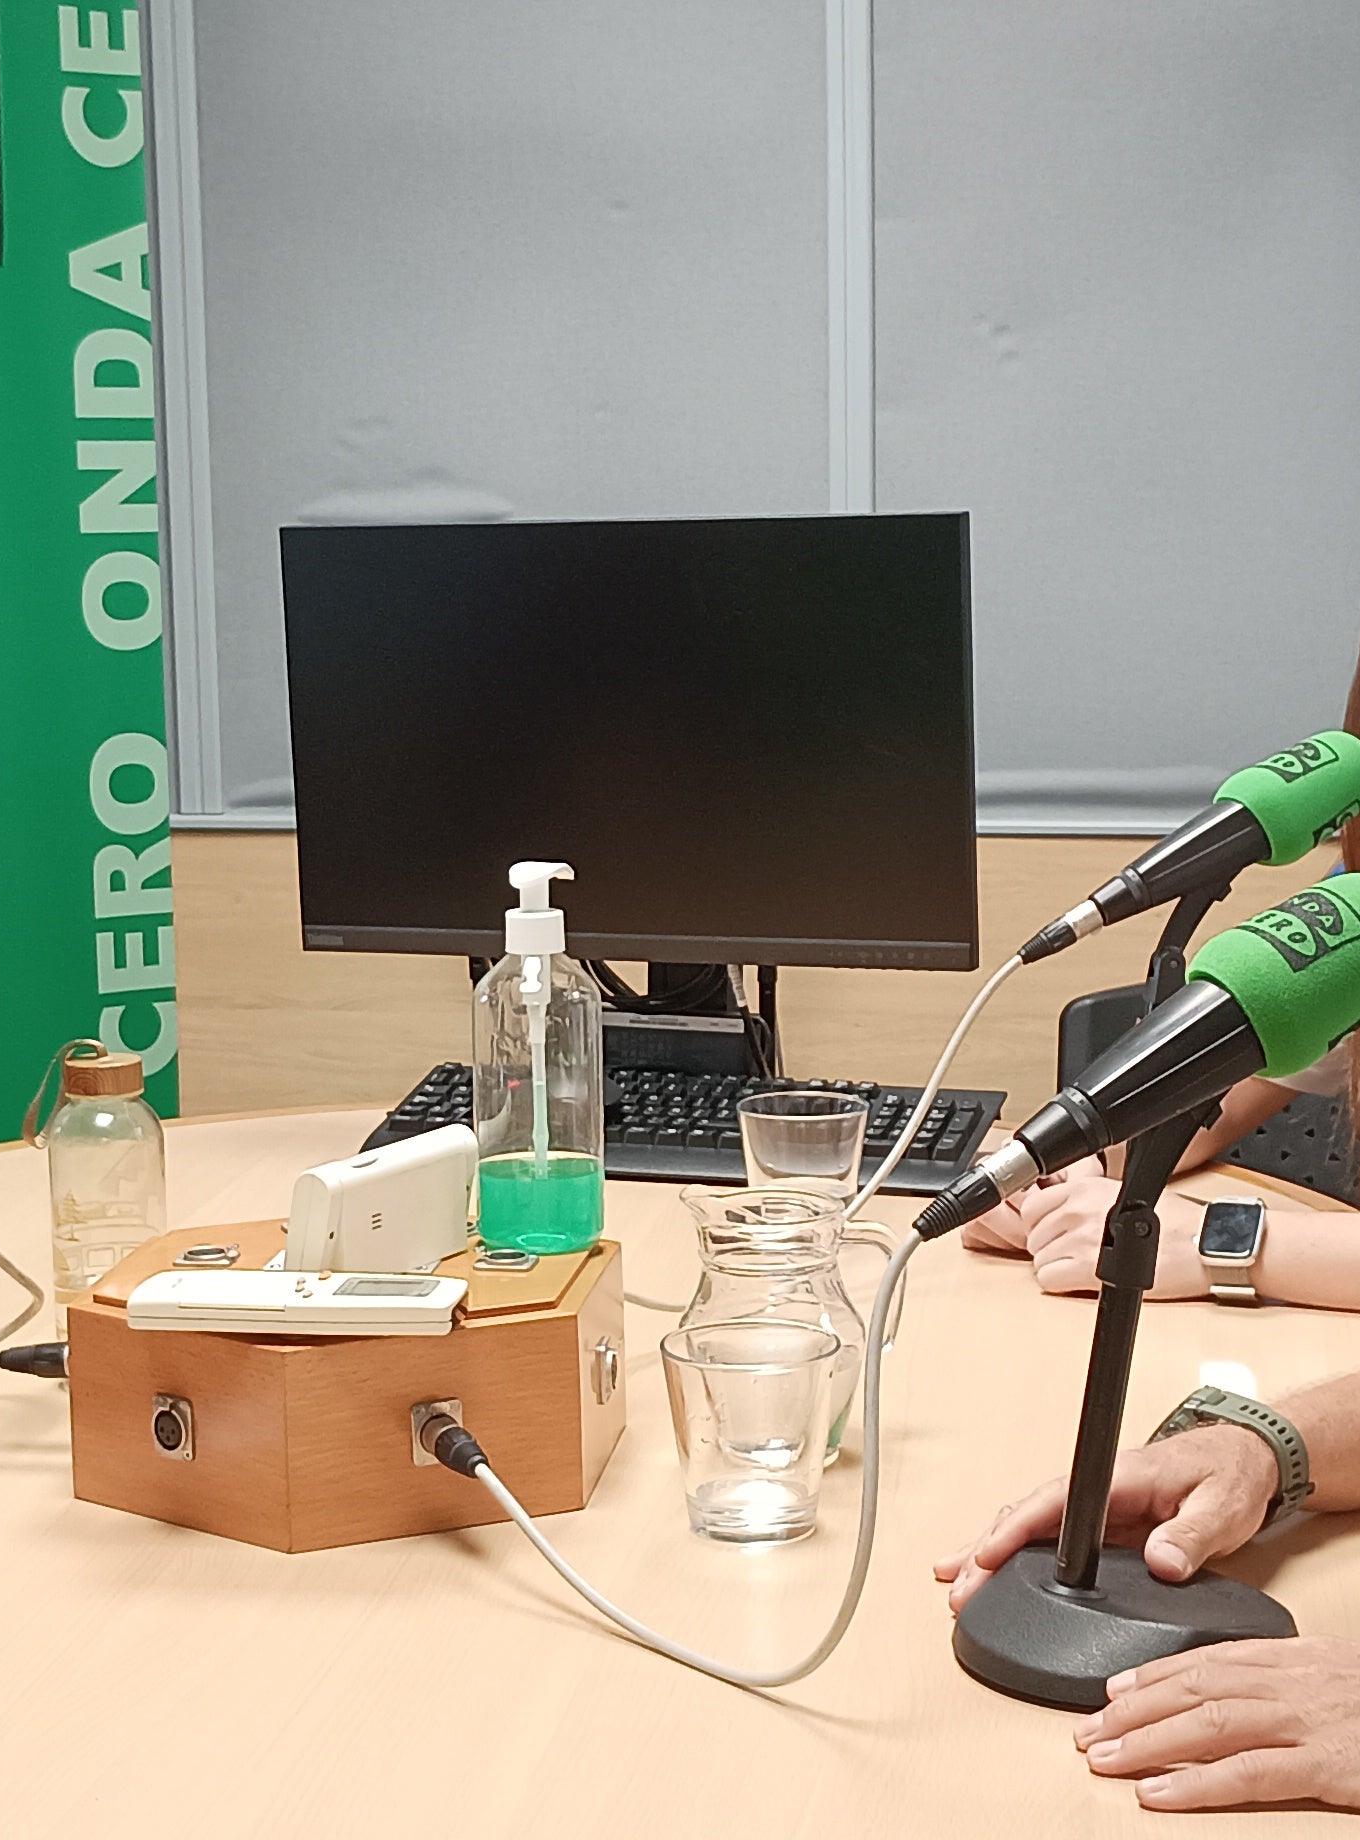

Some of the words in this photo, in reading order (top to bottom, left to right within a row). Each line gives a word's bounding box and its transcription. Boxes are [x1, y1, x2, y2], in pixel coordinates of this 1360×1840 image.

[68, 221, 163, 652] ONDA
[89, 732, 180, 1078] CERO
[1254, 912, 1308, 944] ERO
[1293, 896, 1335, 929] NDA
